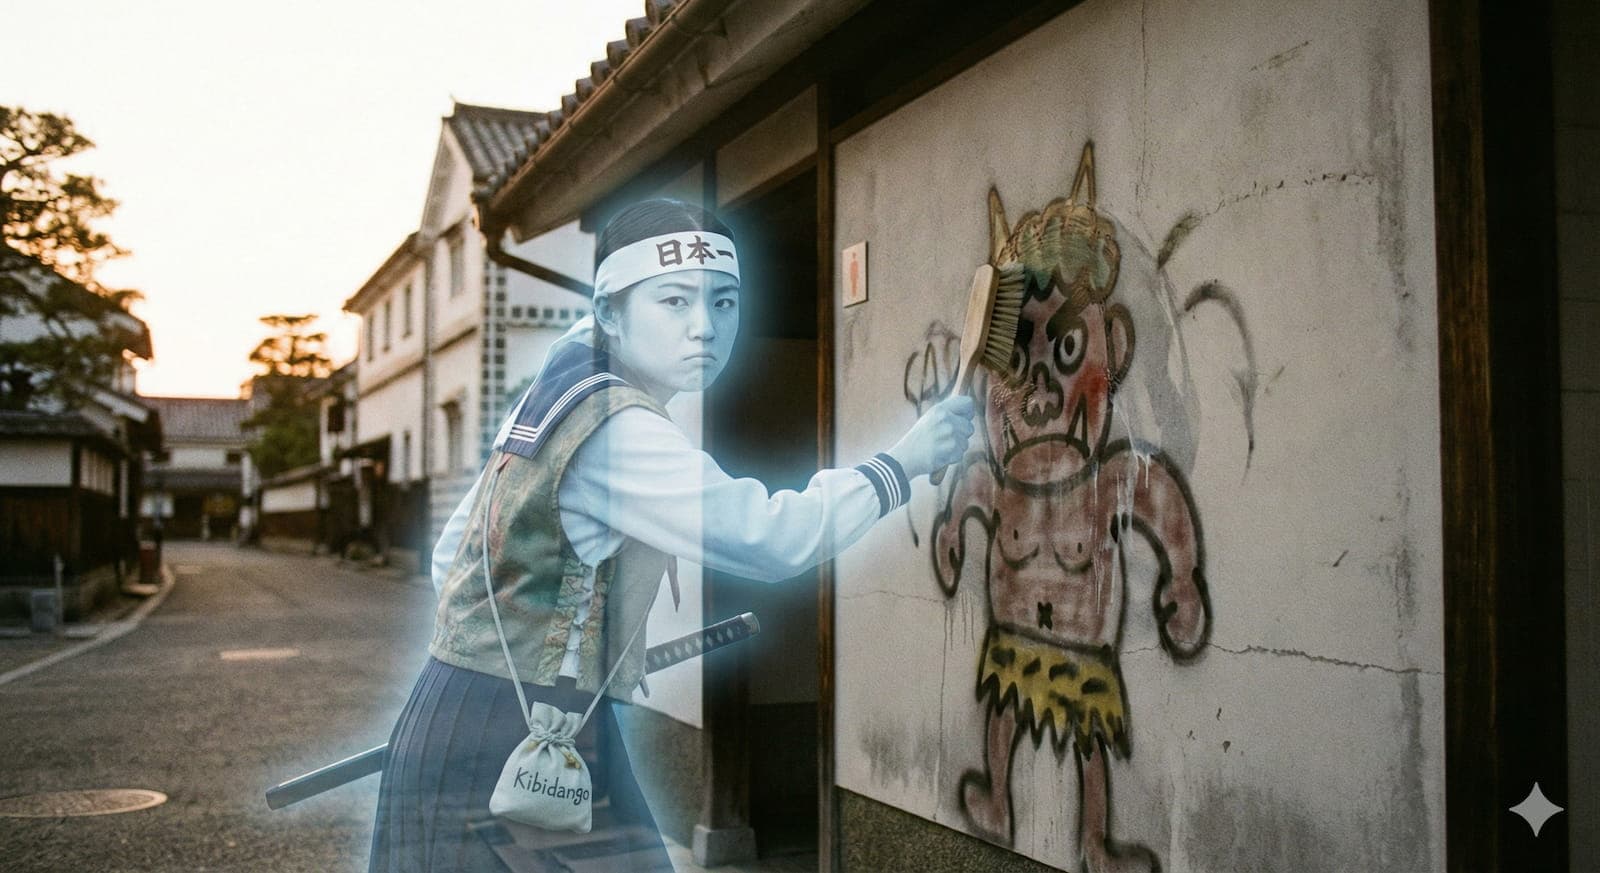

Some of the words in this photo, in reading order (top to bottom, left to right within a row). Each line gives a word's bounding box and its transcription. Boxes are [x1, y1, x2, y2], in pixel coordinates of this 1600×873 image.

[656, 235, 735, 267] 日本一
[513, 767, 590, 806] Kibidango
